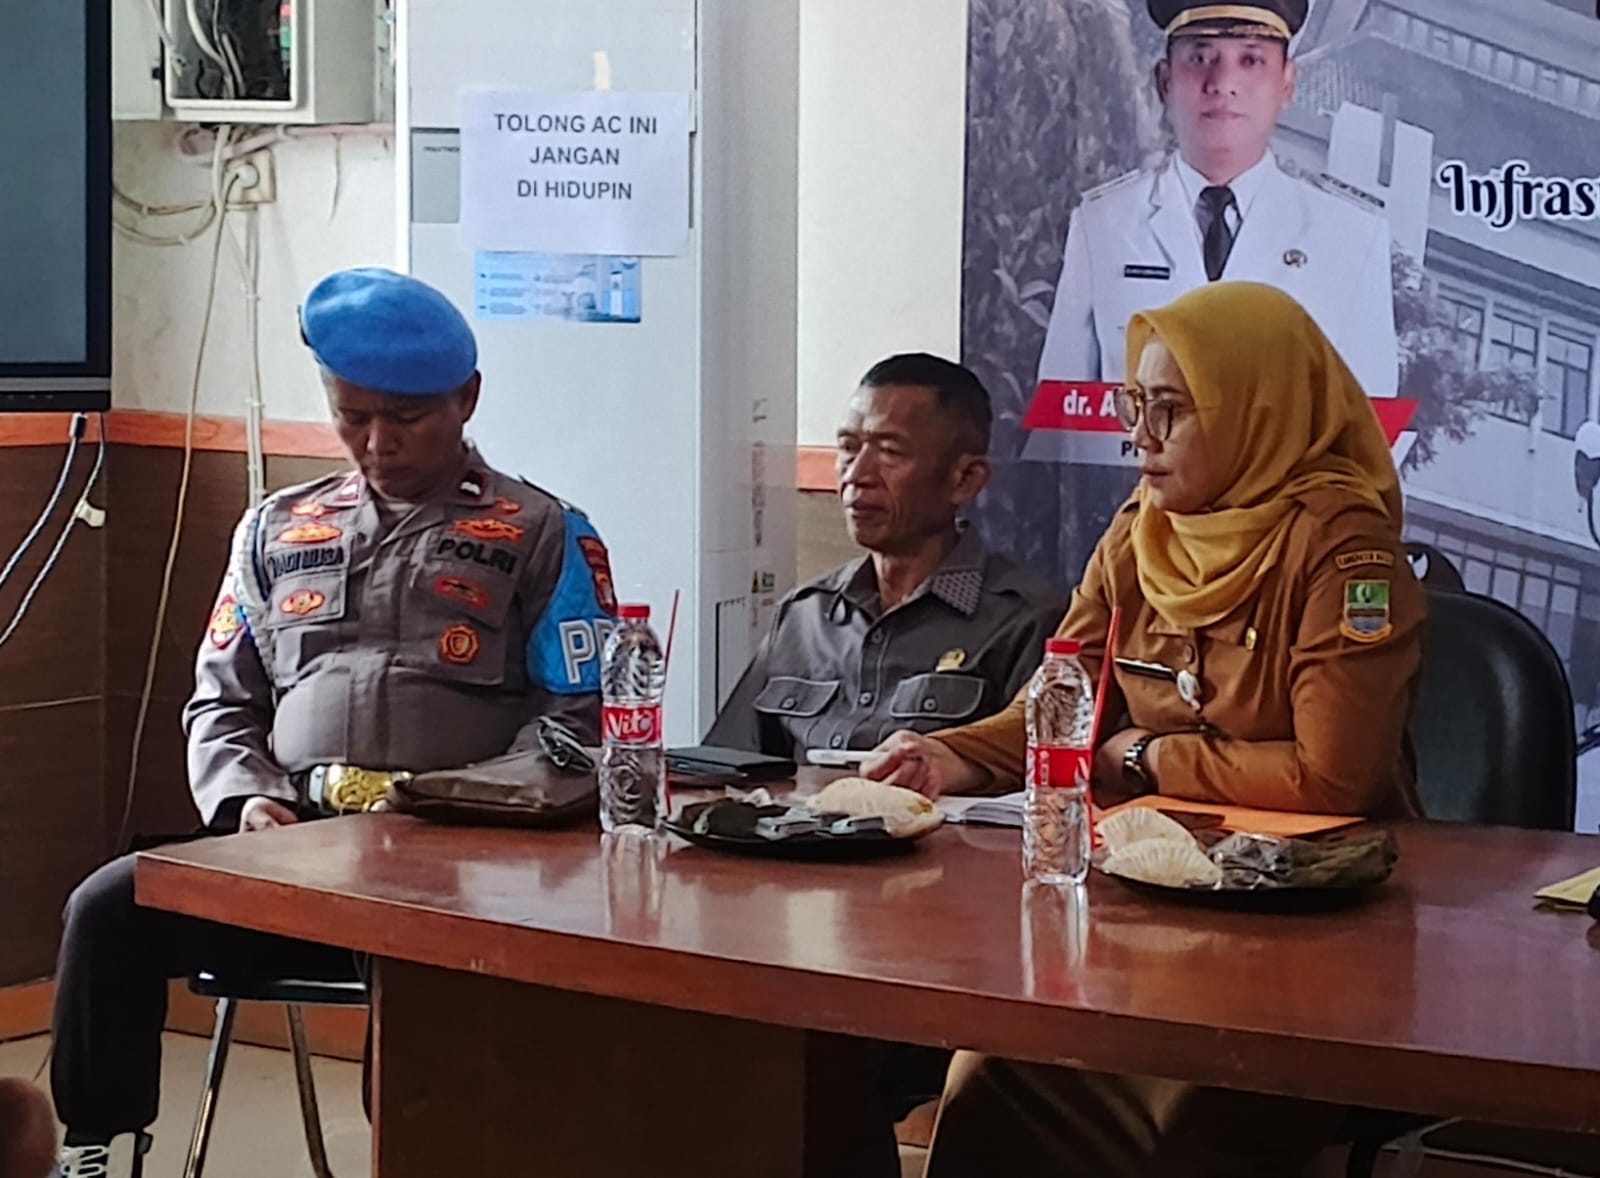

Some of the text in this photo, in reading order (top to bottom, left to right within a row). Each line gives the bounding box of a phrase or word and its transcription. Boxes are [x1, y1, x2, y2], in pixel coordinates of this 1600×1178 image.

[494, 113, 658, 134] TOLONG AC INI
[529, 147, 620, 165] JANGAN
[517, 180, 632, 200] DI HIDUPIN
[1440, 163, 1600, 228] Infras
[1063, 388, 1120, 417] dr. A
[437, 538, 518, 575] POLRI
